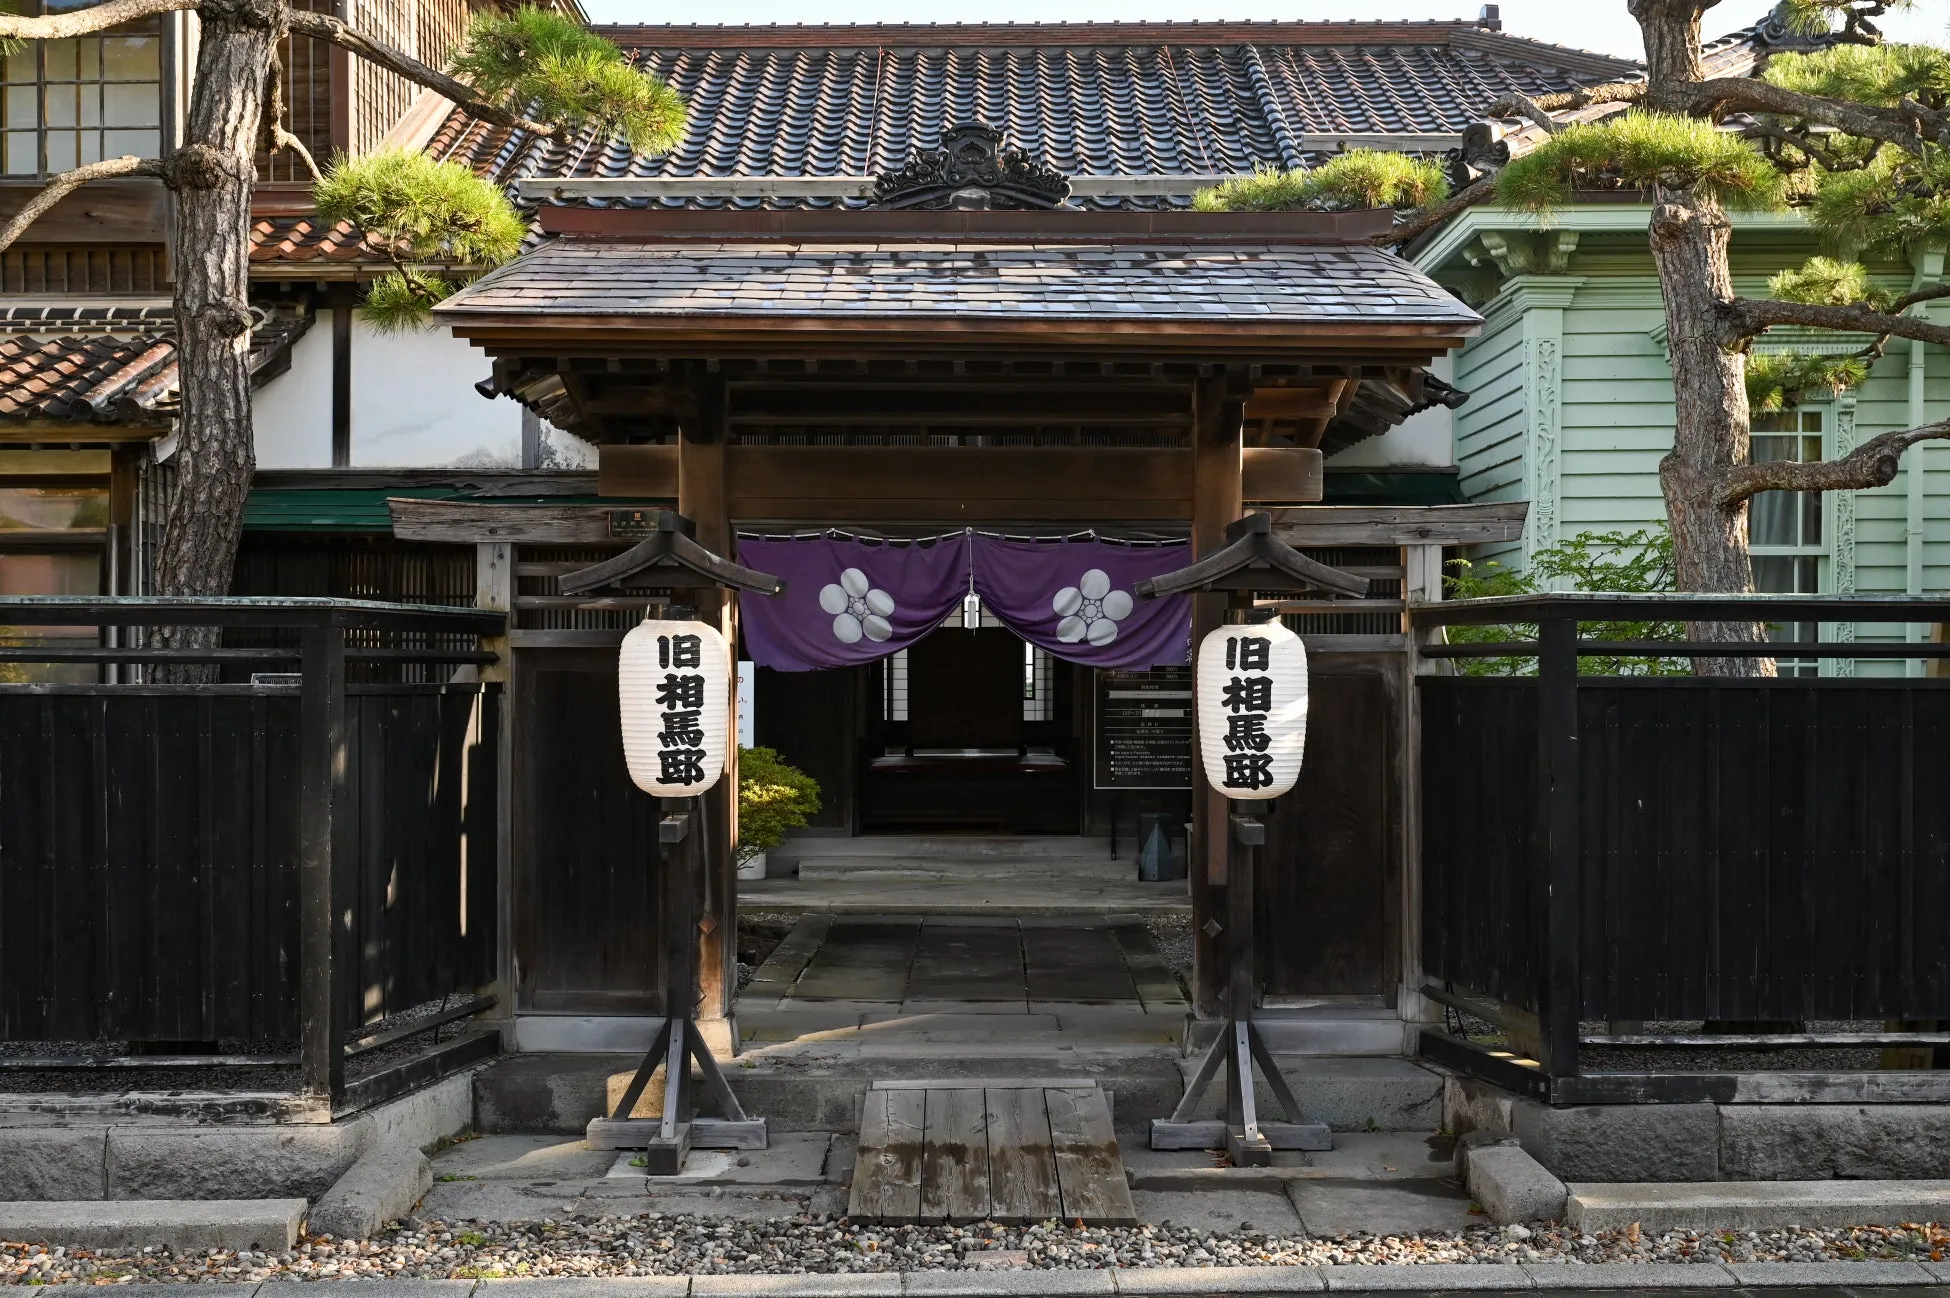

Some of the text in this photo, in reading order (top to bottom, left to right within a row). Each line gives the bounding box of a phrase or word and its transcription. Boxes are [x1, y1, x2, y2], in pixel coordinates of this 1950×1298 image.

[655, 634, 707, 786] 旧相馬邸
[1221, 636, 1274, 791] 旧相馬邸
